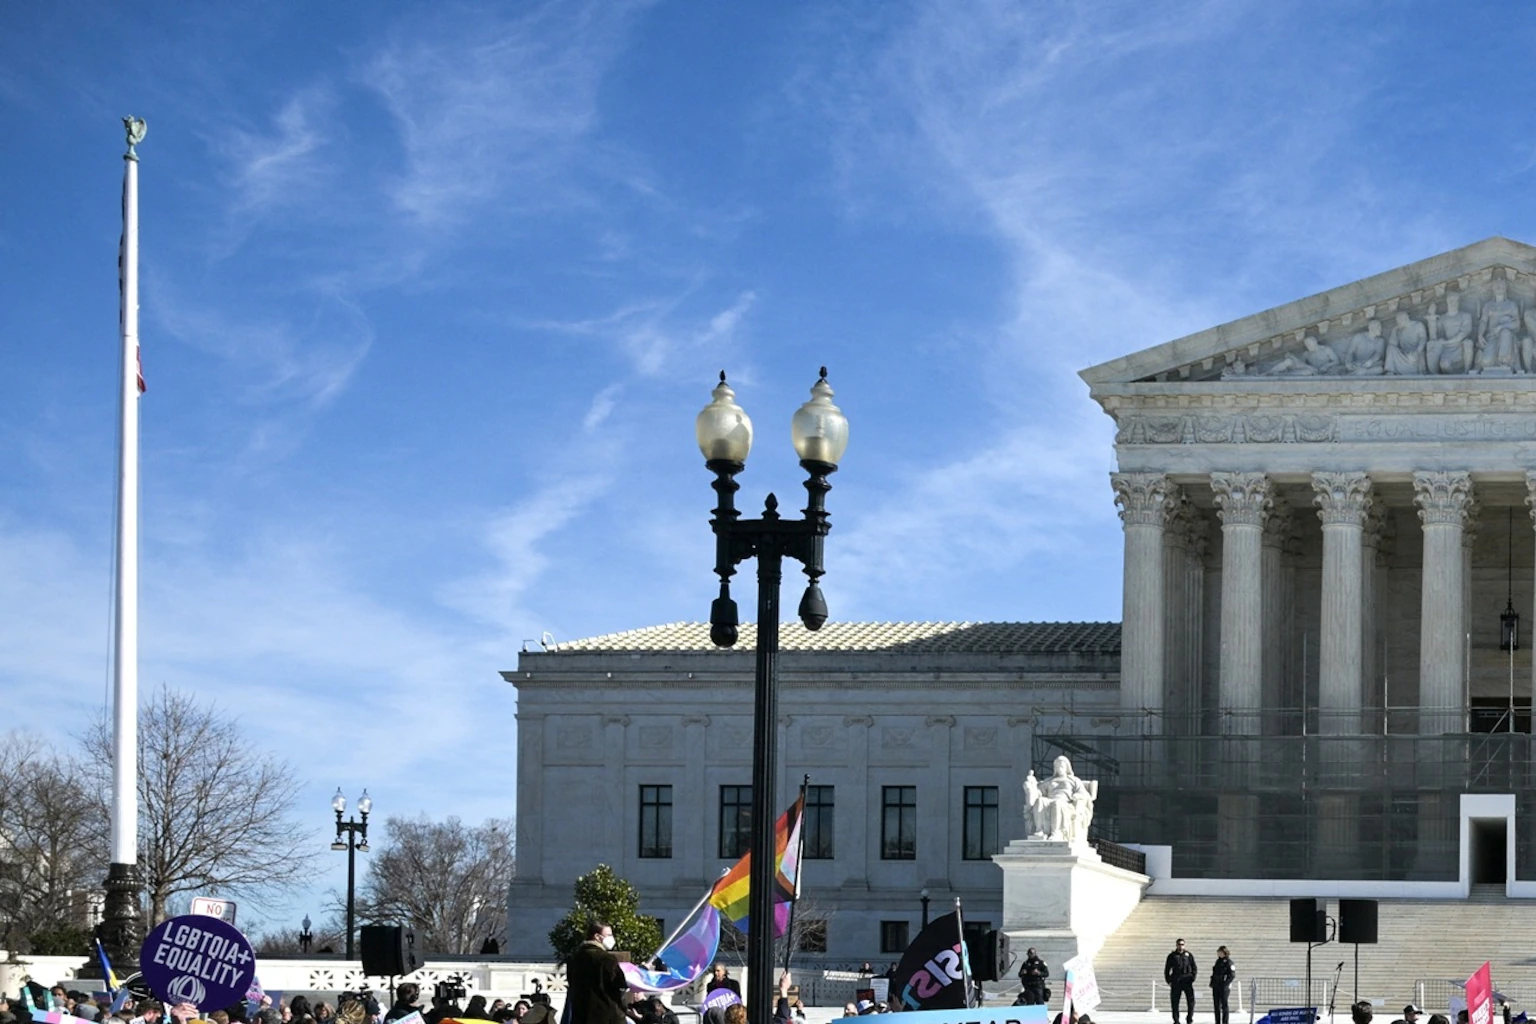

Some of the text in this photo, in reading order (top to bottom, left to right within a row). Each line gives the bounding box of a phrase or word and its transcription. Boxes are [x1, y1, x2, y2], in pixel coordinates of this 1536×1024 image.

[1354, 421, 1426, 437] EQUAL
[1431, 420, 1517, 439] JUSTICE
[206, 904, 223, 915] NO
[162, 921, 252, 965] LGBTQIA+
[153, 943, 245, 988] EQUALITY
